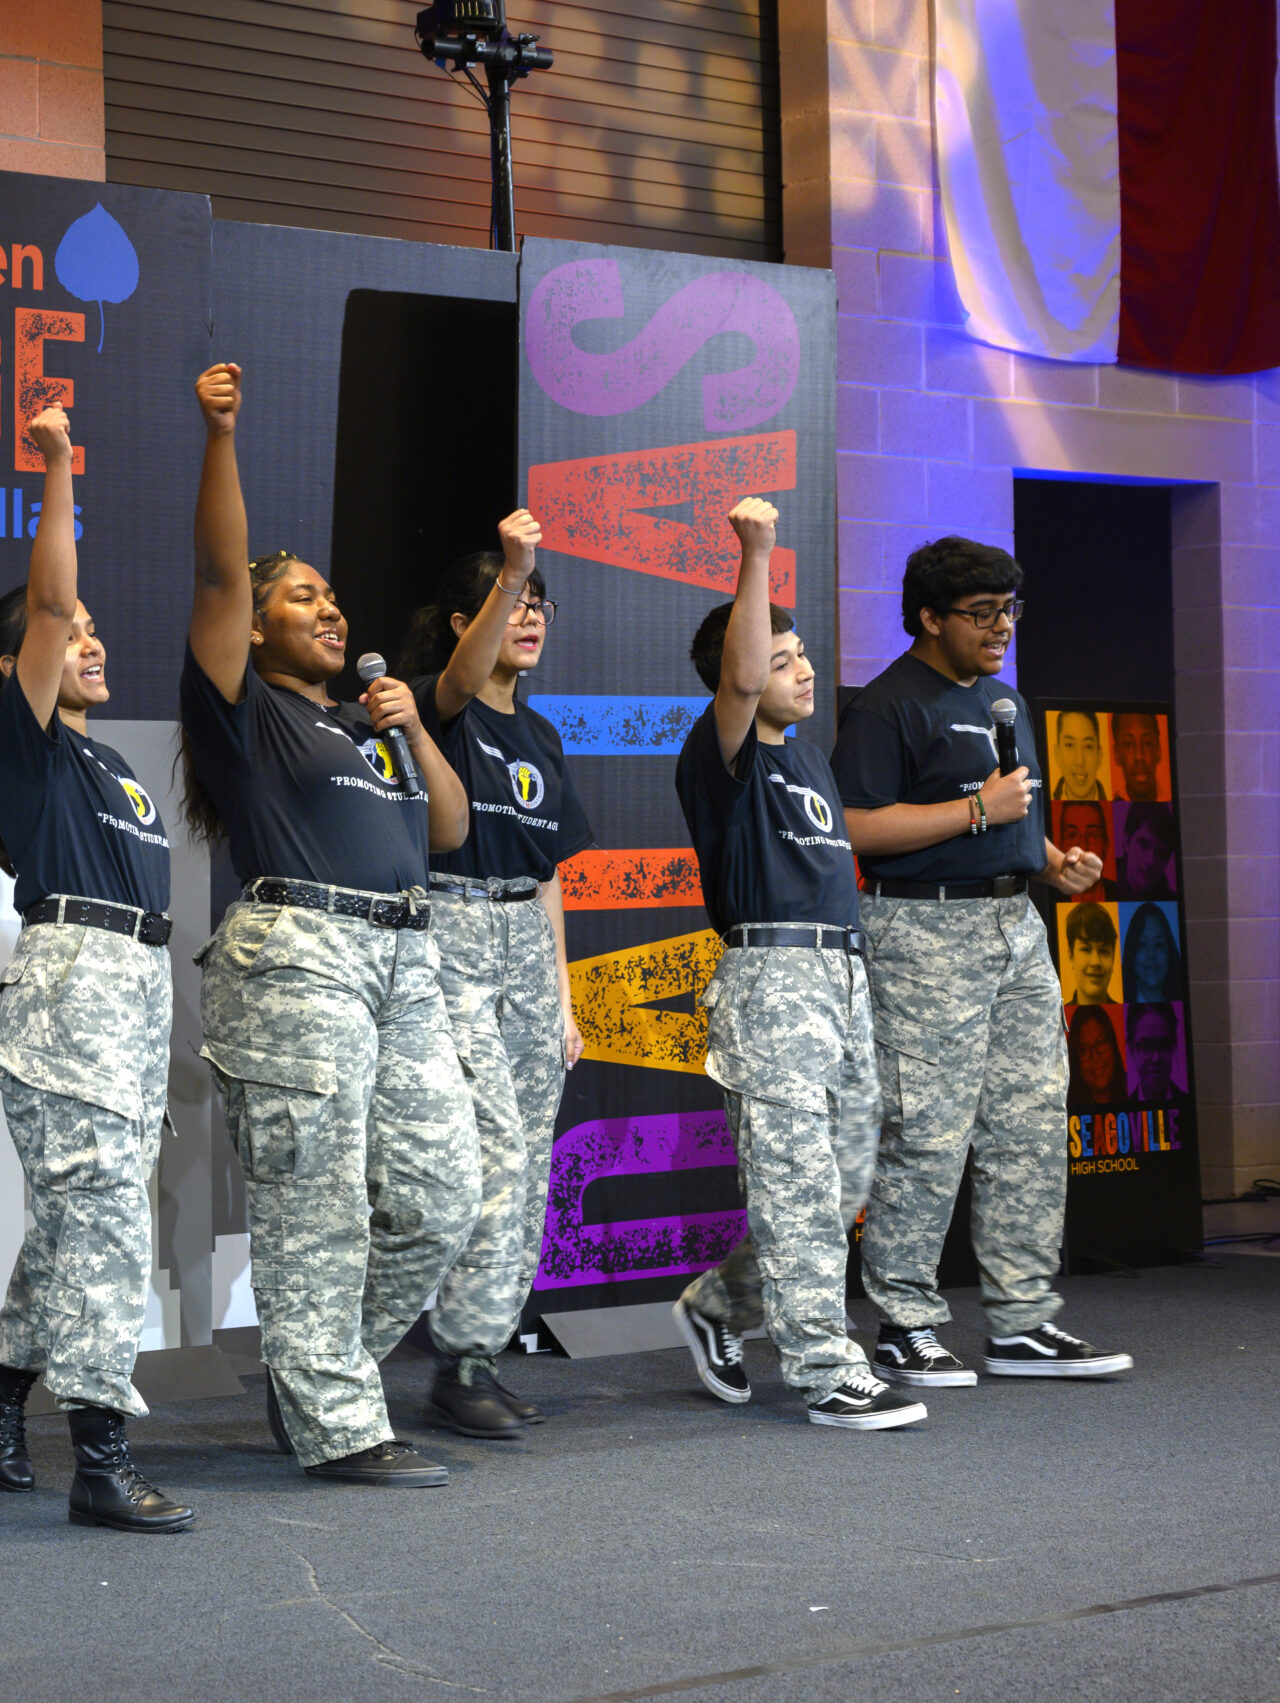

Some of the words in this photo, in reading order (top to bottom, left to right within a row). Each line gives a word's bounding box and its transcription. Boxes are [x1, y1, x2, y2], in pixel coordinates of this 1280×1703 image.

[387, 790, 424, 801] STUT
[517, 814, 547, 828] TUDENT
[1069, 1109, 1181, 1158] SEAGOVILLE
[1071, 1160, 1095, 1175] HIGH
[1097, 1158, 1139, 1174] SCHOOL
